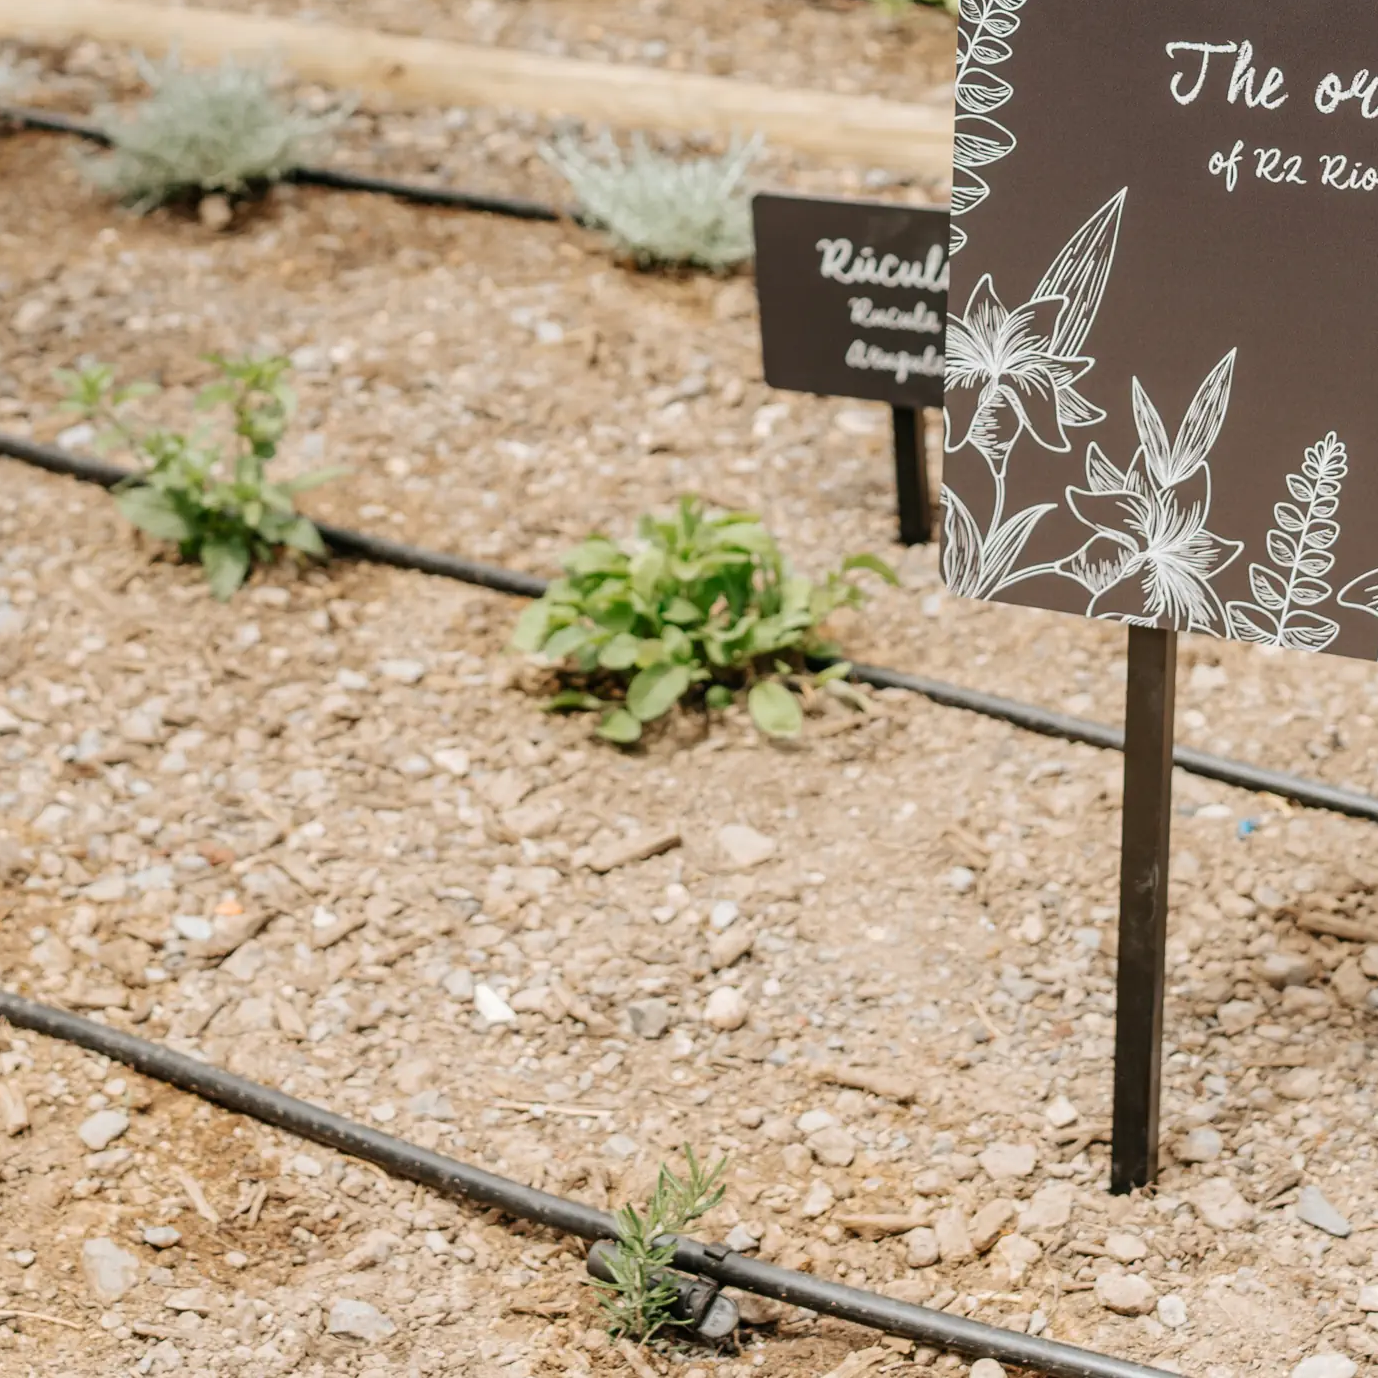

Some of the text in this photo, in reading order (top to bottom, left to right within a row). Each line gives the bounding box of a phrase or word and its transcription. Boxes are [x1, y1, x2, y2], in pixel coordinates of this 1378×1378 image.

[1165, 39, 1289, 111] The
[1208, 139, 1245, 193] of
[1253, 147, 1308, 185] R2
